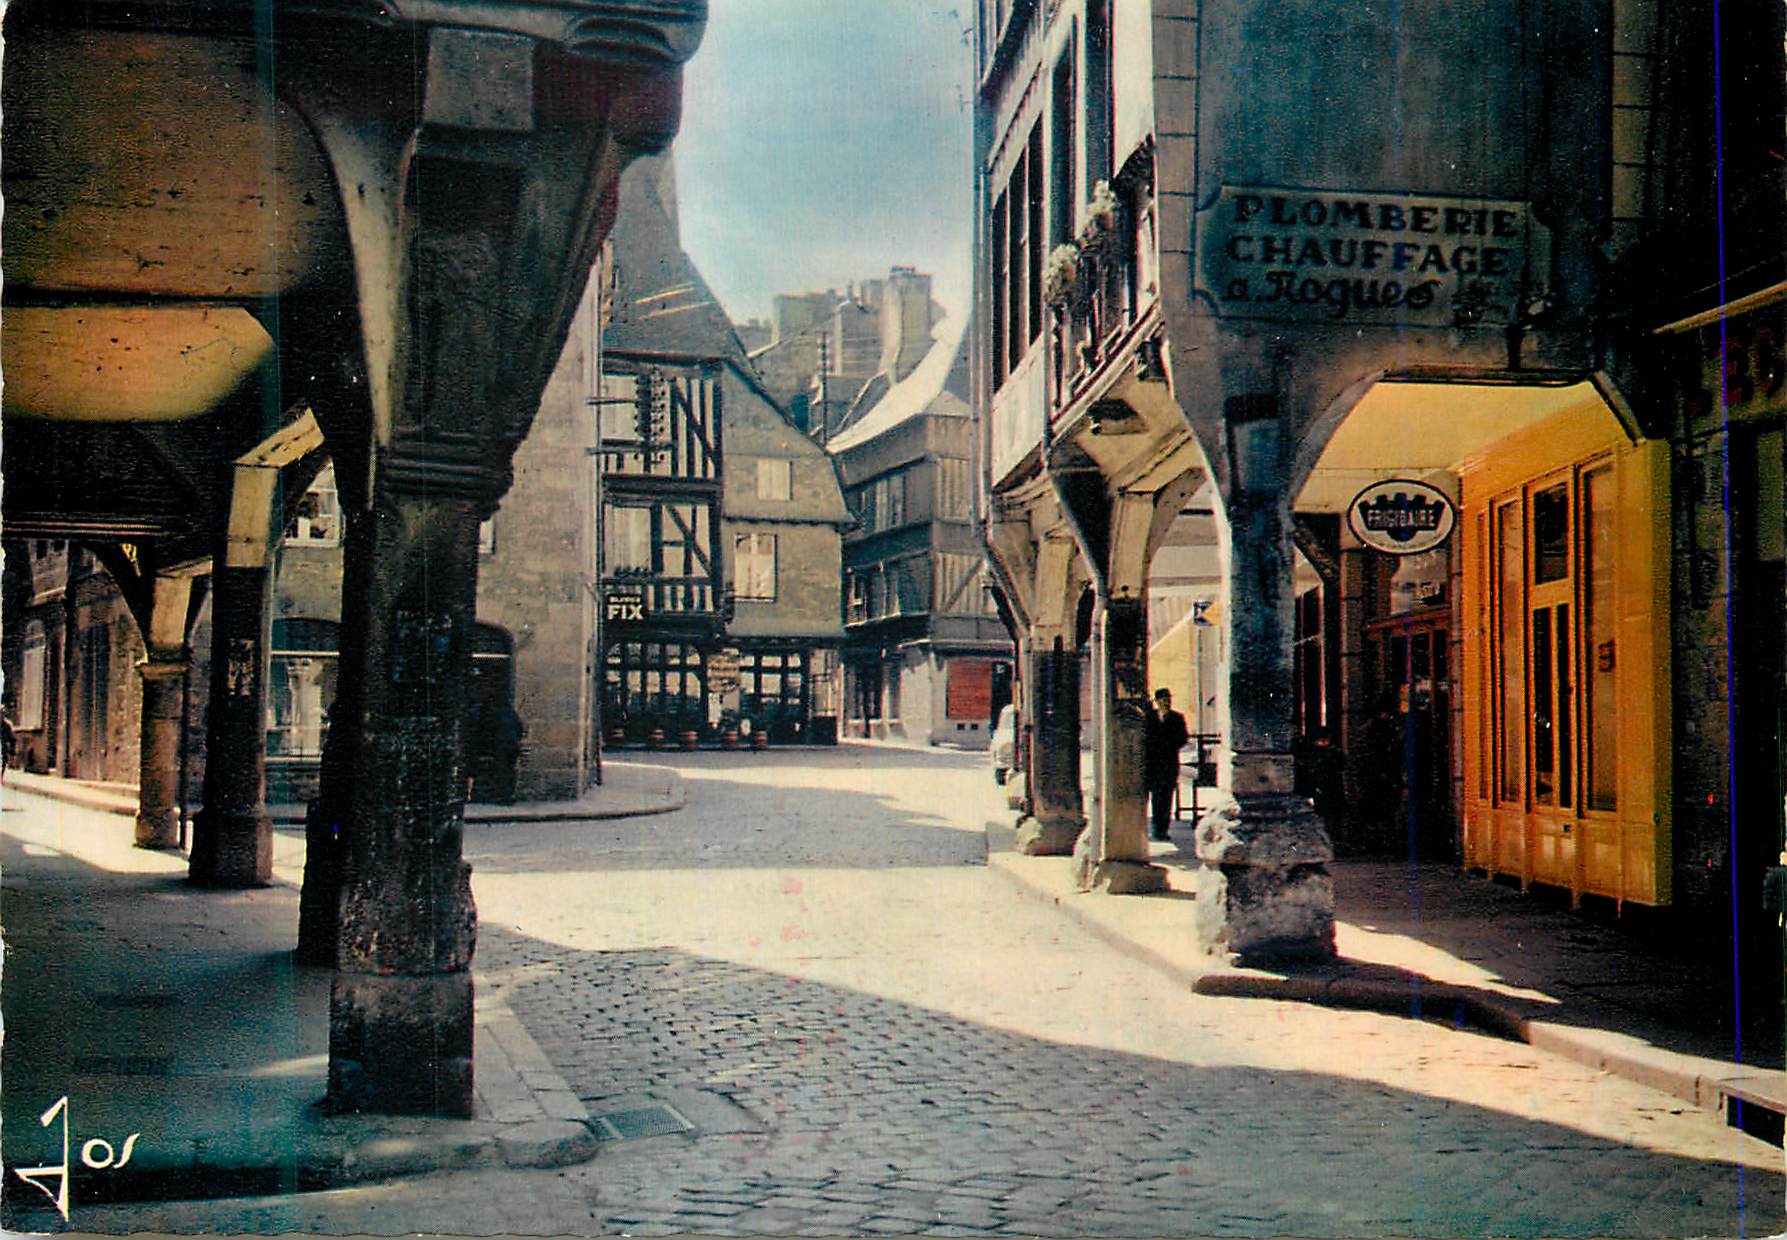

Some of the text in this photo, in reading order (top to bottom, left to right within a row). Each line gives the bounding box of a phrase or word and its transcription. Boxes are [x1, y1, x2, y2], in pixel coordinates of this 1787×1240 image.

[1233, 194, 1519, 238] PLOMBERIE
[1227, 235, 1511, 276] CHAUFFAGE
[607, 604, 644, 620] FIX
